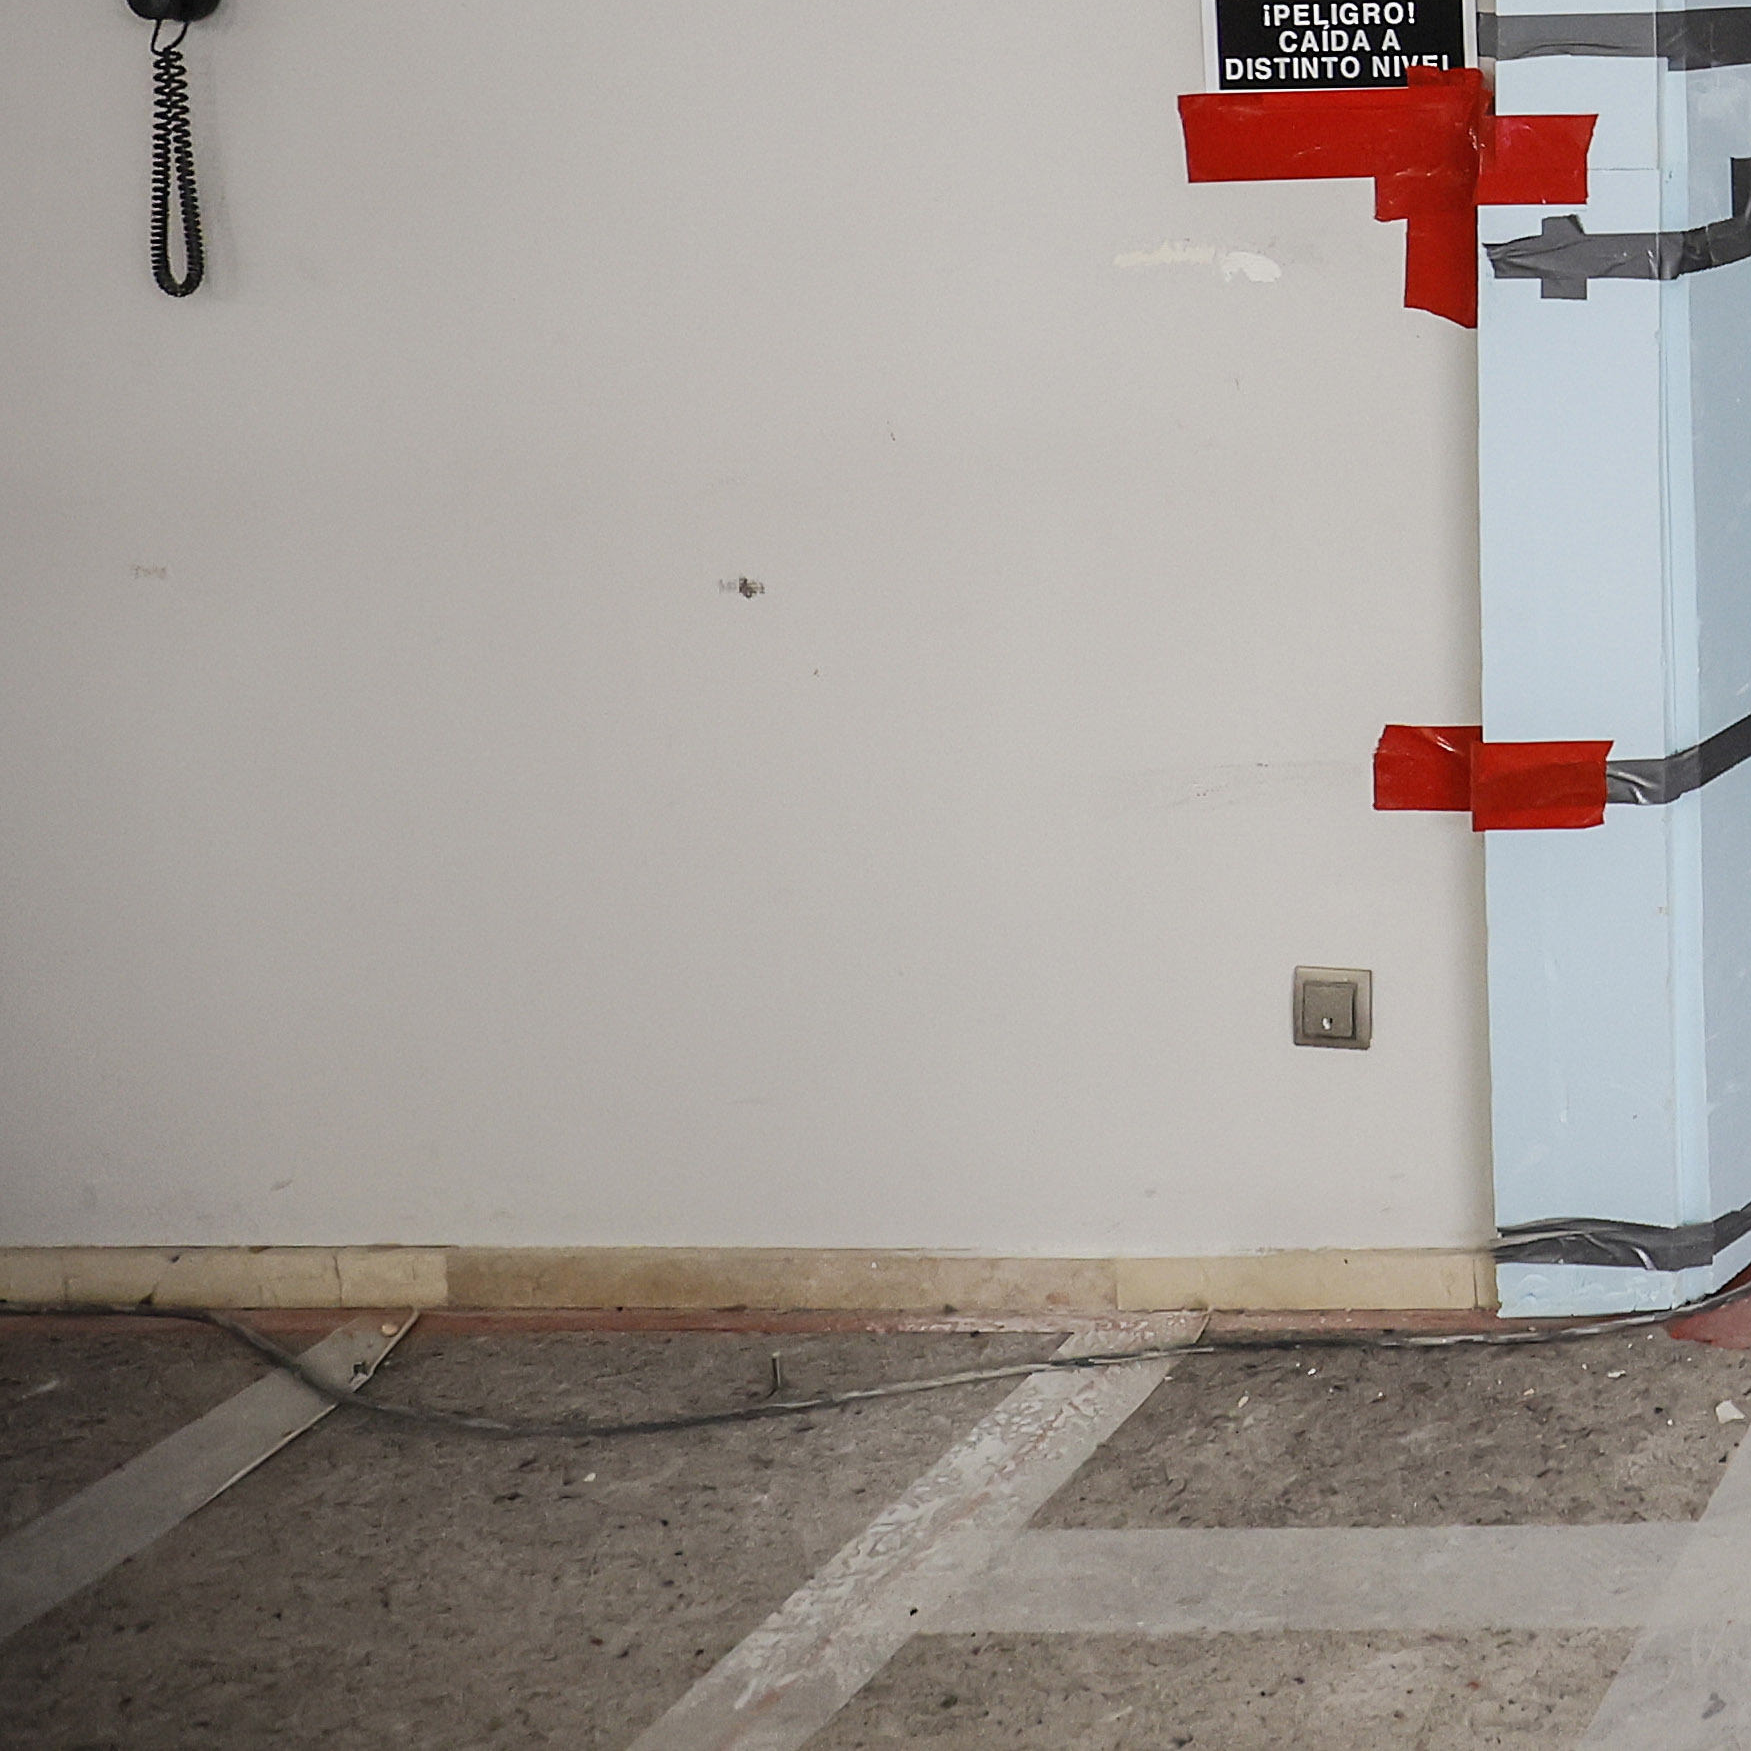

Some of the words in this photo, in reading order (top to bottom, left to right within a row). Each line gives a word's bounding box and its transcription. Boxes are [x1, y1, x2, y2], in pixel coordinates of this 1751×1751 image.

[1263, 1, 1416, 27] ¡PELIGRO!
[1279, 24, 1371, 54] CAÍDA
[1381, 29, 1402, 52] A
[1224, 55, 1361, 82] DISTINTO
